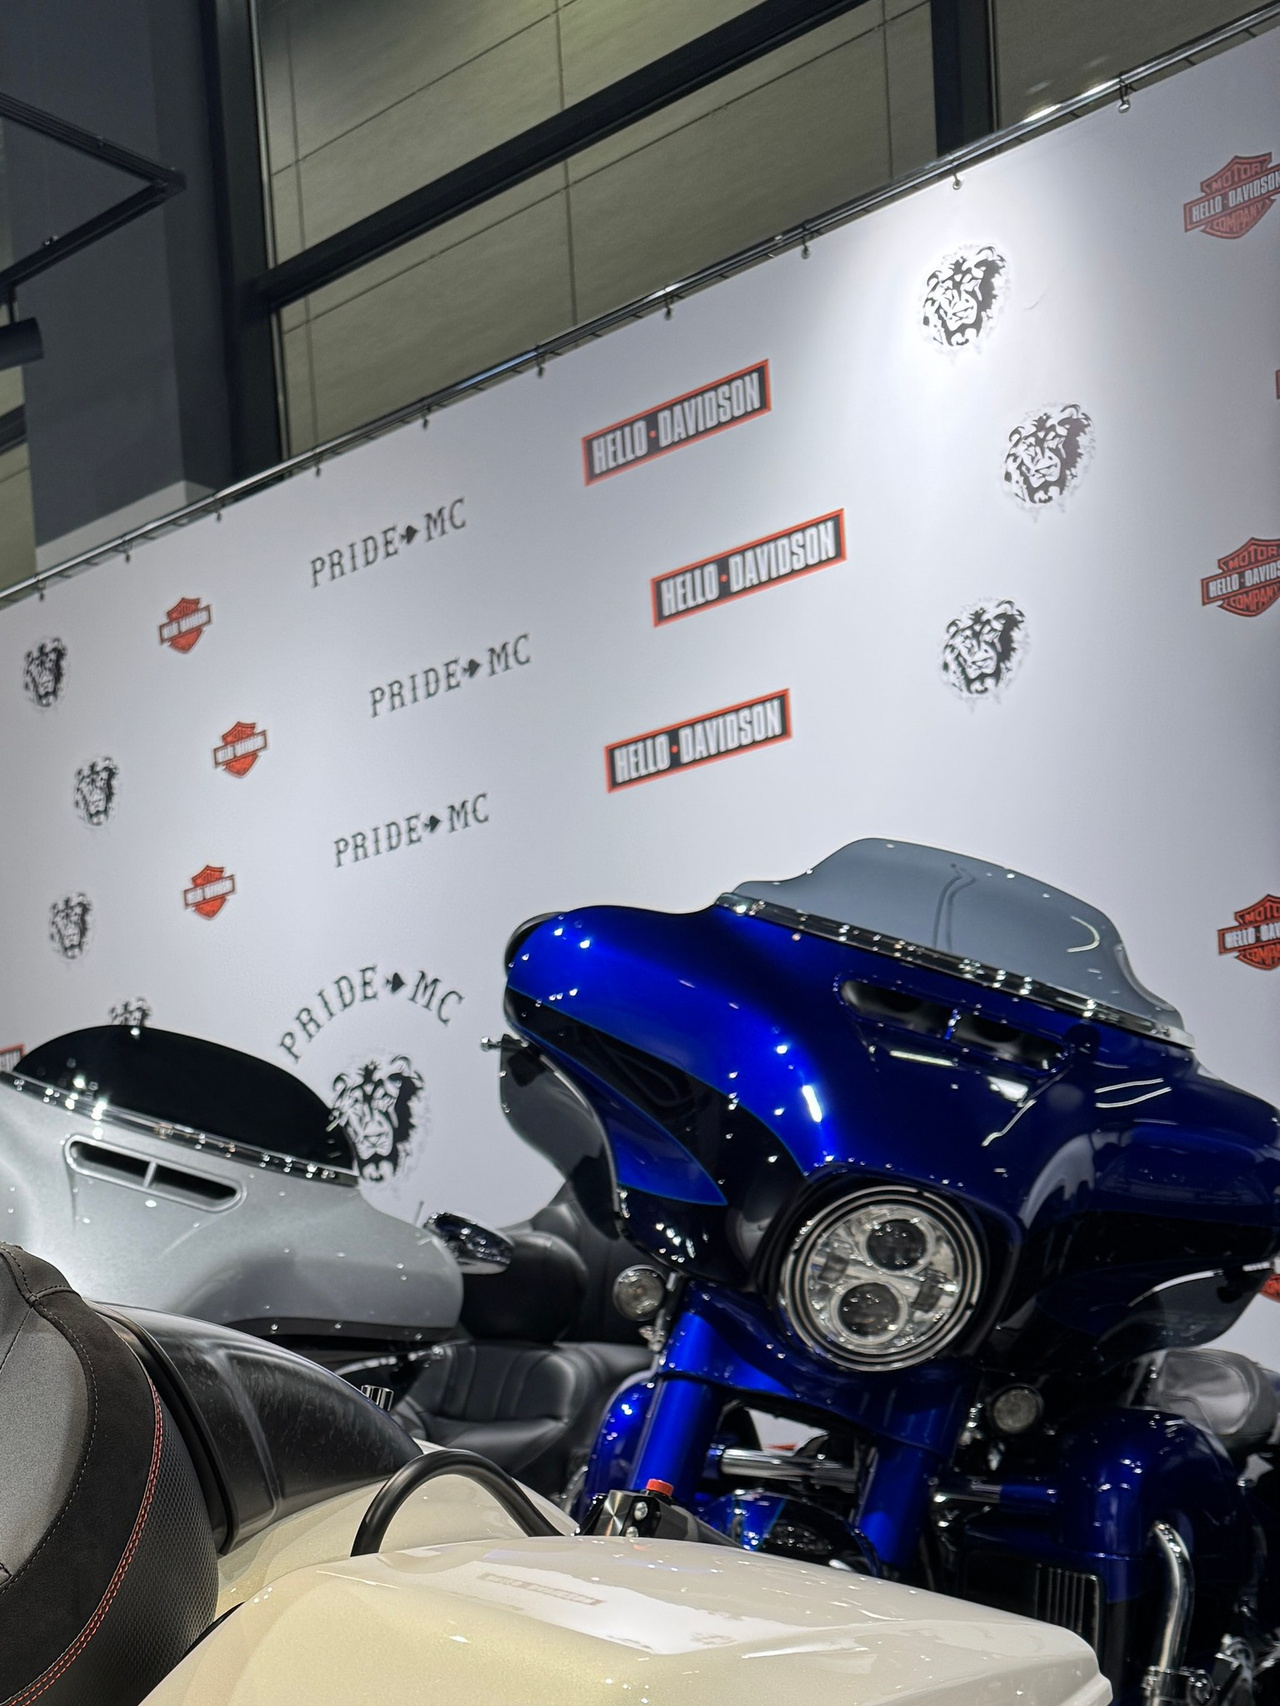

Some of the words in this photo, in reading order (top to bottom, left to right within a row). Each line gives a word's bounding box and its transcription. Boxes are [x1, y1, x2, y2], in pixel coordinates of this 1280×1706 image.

[1192, 195, 1222, 222] HELLO
[592, 419, 649, 475] HELLO
[657, 372, 761, 448] DAVIDSON
[310, 524, 399, 588] PRIDE
[423, 497, 467, 542] MC
[660, 562, 720, 617] HELLO
[728, 520, 836, 593] DAVIDSON
[1208, 573, 1240, 598] HELLO
[369, 657, 462, 718] PRIDE
[486, 632, 532, 677] MC
[614, 733, 671, 784] HELLO
[678, 697, 783, 765] DAVIDSON
[333, 813, 423, 868] PRIDE
[446, 792, 490, 833] MC
[278, 965, 379, 1065] PRIDE
[408, 970, 465, 1027] MC
